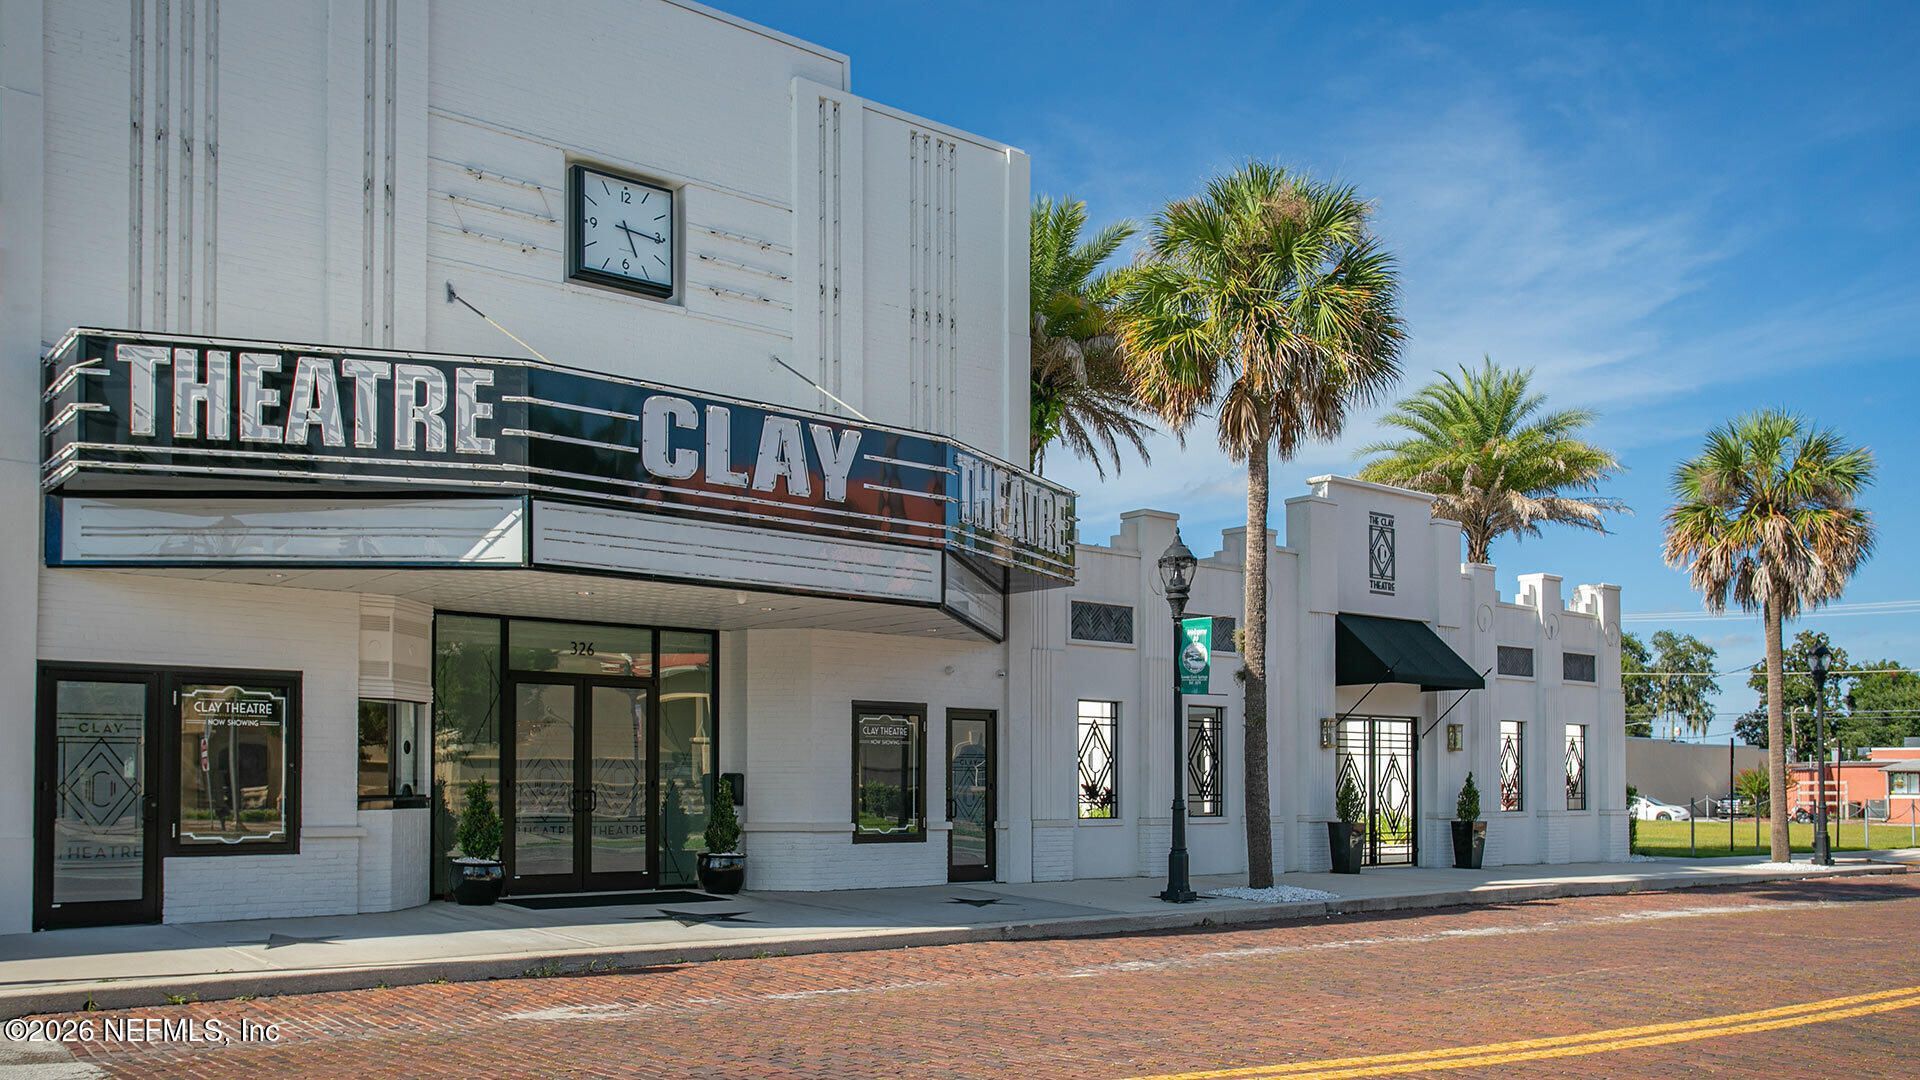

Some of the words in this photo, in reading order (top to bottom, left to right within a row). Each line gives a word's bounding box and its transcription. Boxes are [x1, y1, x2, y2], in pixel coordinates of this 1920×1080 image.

[620, 190, 632, 204] 12
[589, 216, 598, 228] 9
[654, 232, 663, 244] 3
[621, 258, 630, 270] 6
[116, 344, 496, 455] THEATRE
[641, 395, 862, 502] CLAY
[955, 453, 1071, 557] THEATRE
[1369, 516, 1379, 525] THE
[1381, 518, 1394, 527] CLAY
[1369, 580, 1395, 592] THEATRE
[570, 641, 595, 656] 326
[193, 701, 223, 713] CLAY
[225, 702, 273, 714] THEATRE
[78, 722, 124, 733] CLAY
[227, 719, 259, 727] SHOWING
[862, 726, 880, 735] CLAY
[880, 726, 908, 736] THEATRE
[593, 825, 646, 835] THEATRE
